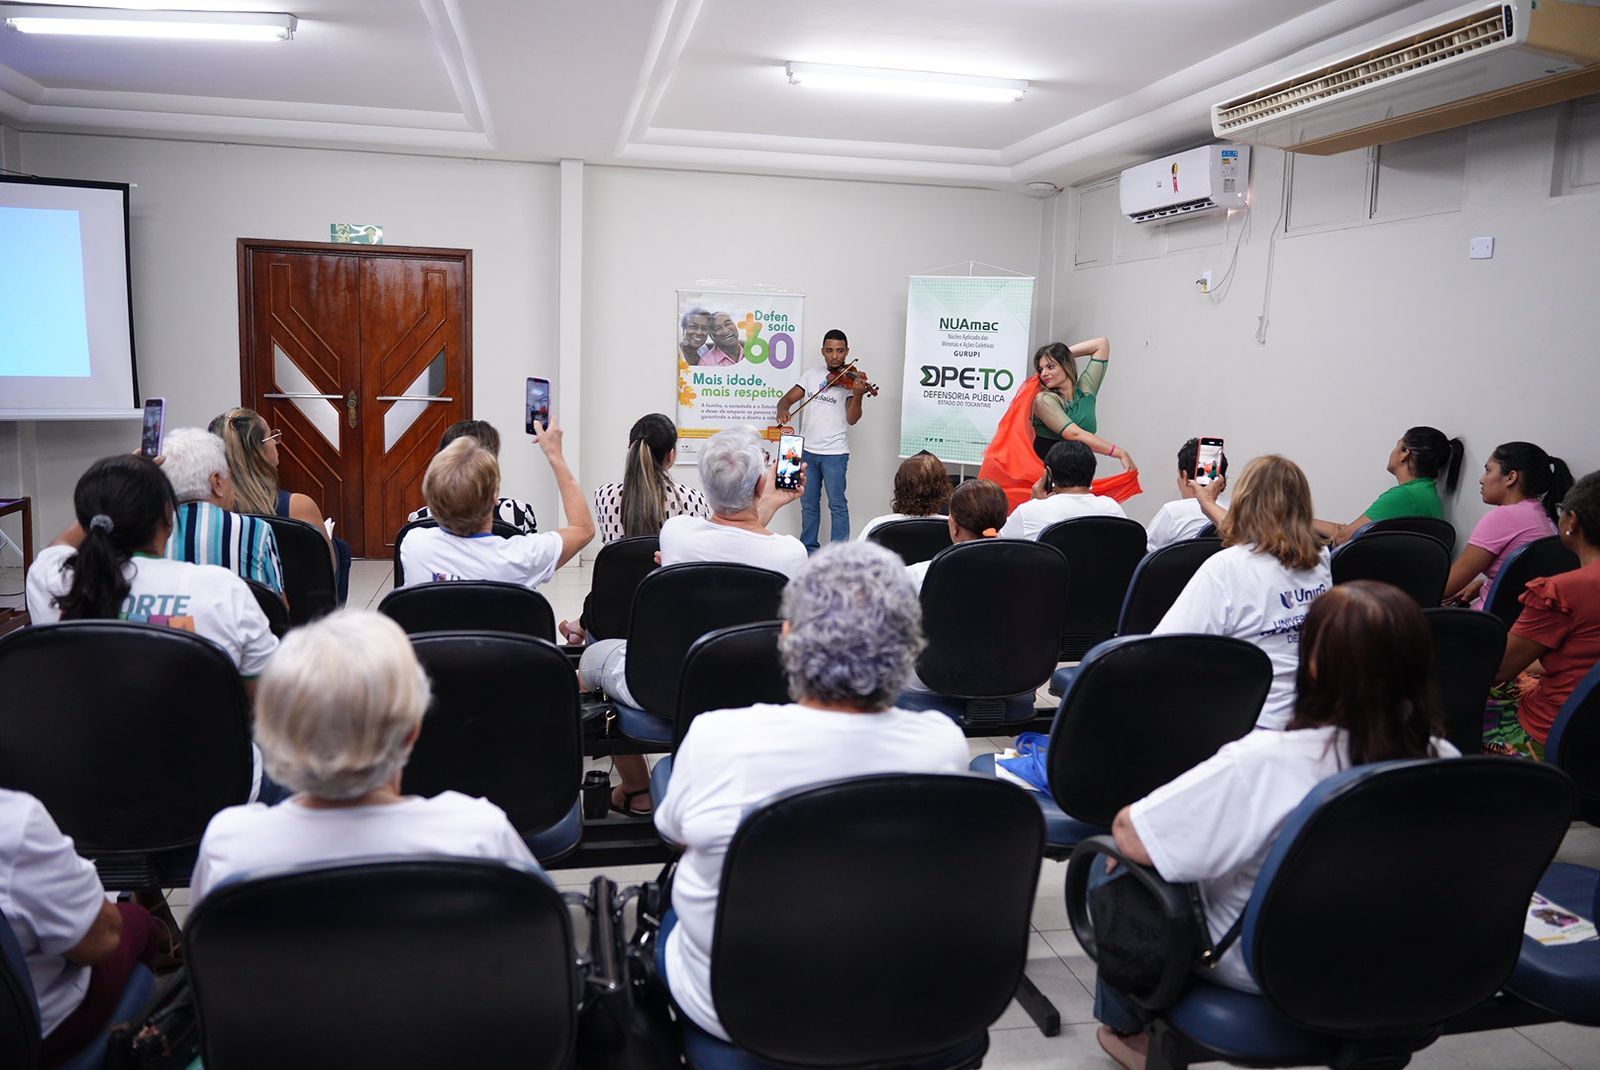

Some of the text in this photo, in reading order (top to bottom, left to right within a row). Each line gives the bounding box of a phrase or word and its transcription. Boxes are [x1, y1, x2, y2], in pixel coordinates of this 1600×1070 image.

[754, 310, 788, 321] Defen
[768, 323, 795, 332] soria
[939, 317, 999, 331] NUAmac
[953, 350, 981, 358] GURUPI
[693, 372, 766, 387] Mais idade,
[701, 386, 784, 400] mais respeito
[923, 390, 1005, 403] DEFENSORIA PÚBLICA
[119, 593, 192, 617] ORTE
[1273, 614, 1305, 630] UNIVER
